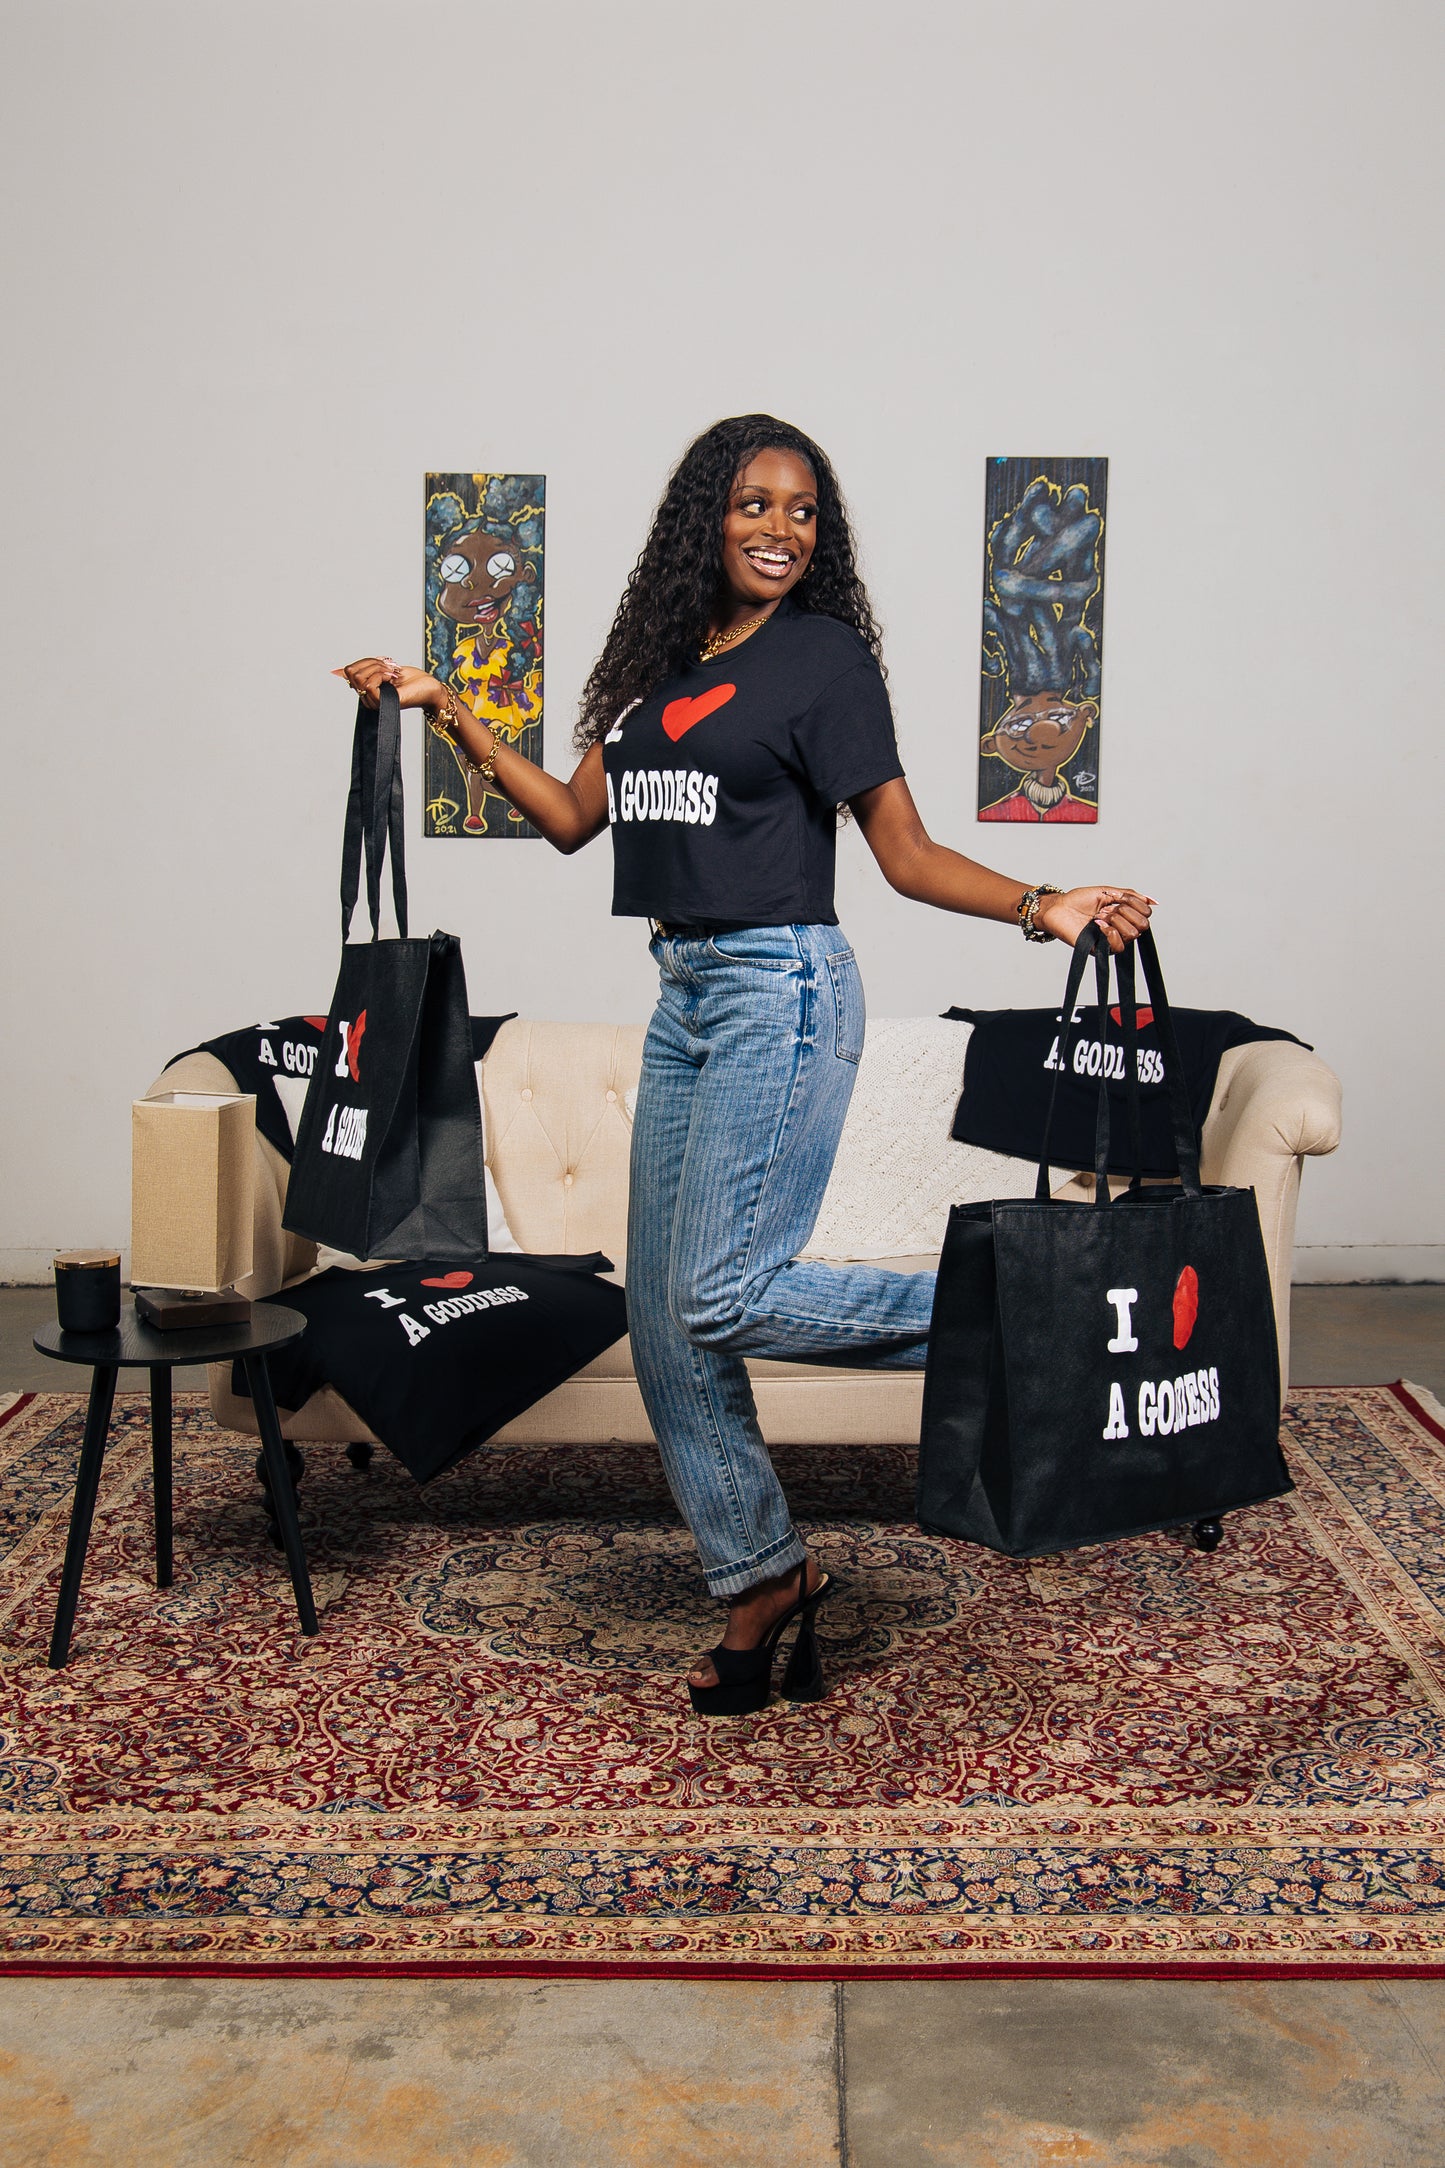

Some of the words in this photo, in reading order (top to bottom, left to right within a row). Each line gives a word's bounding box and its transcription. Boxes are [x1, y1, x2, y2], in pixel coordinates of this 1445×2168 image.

[606, 772, 617, 823] A
[620, 769, 719, 826] GODDESS
[258, 1038, 278, 1066] A
[335, 1021, 350, 1078] I
[1043, 1035, 1066, 1071] A
[321, 1103, 339, 1153] A
[364, 1288, 407, 1309] I
[398, 1313, 431, 1347] A
[423, 1285, 530, 1325] GODDESS
[1106, 1288, 1139, 1353] I
[1102, 1382, 1130, 1440] A
